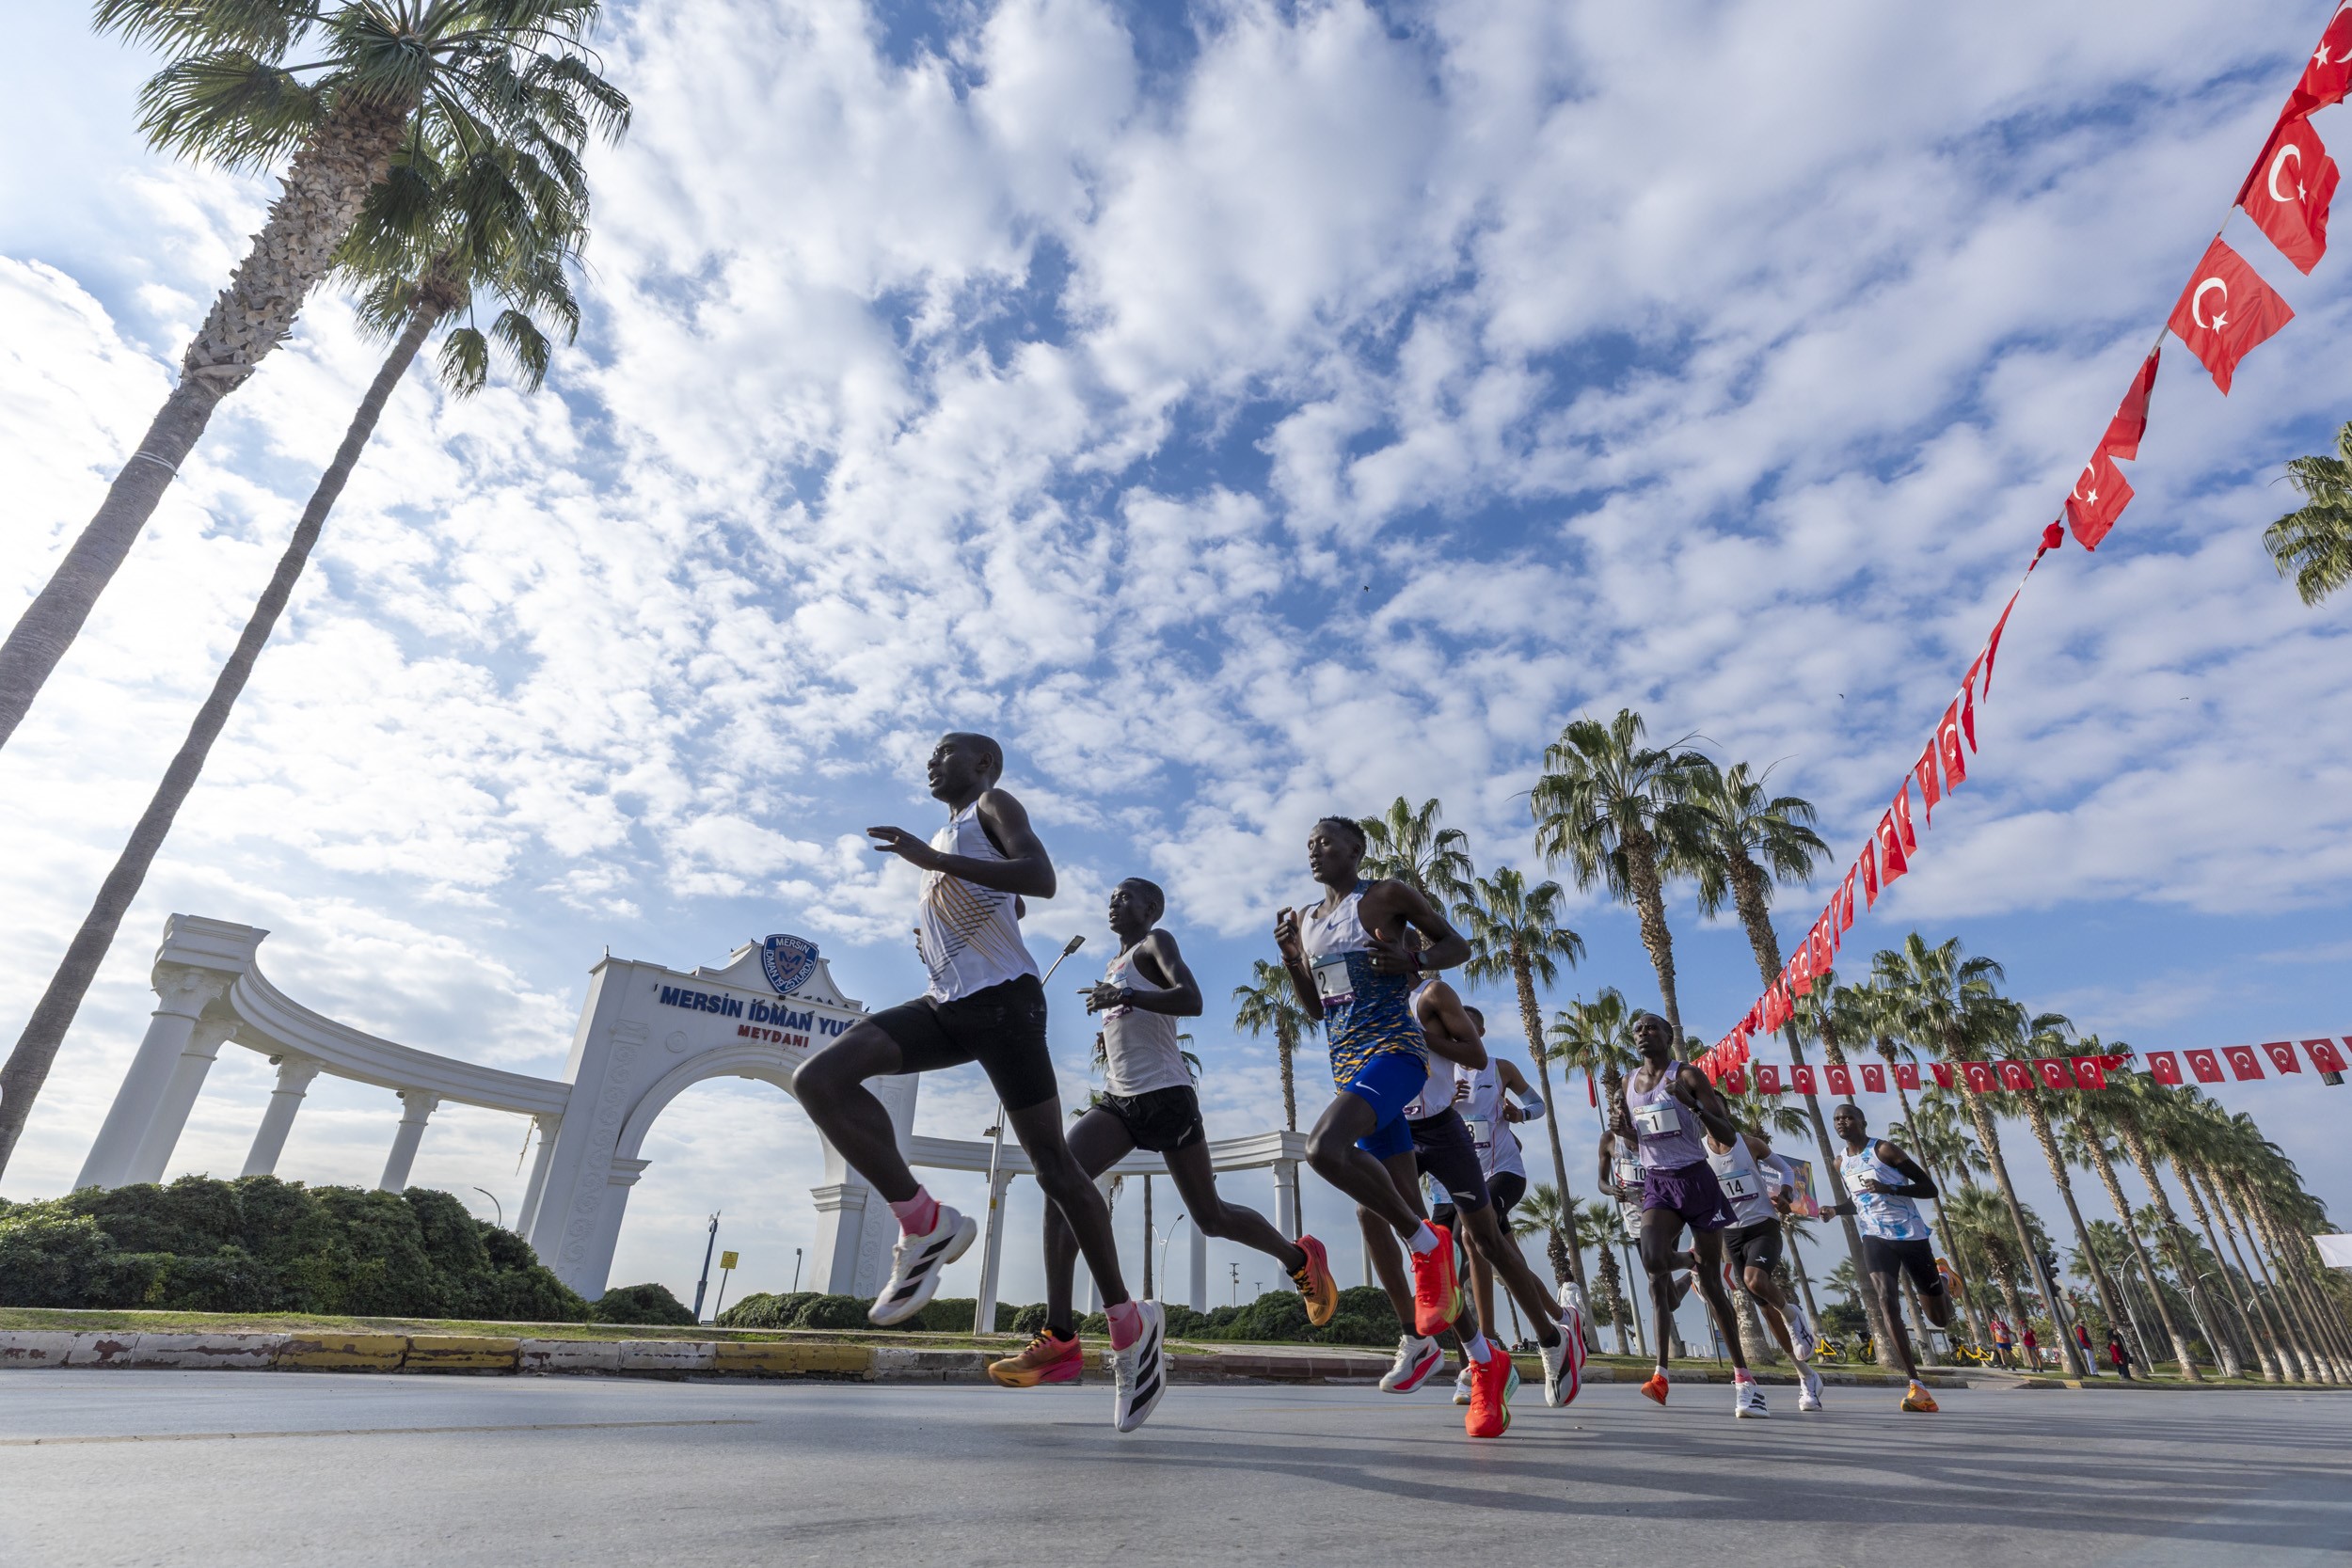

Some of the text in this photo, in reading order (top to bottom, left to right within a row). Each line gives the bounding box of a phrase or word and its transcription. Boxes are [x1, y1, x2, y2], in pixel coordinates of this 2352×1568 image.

[776, 938, 810, 954] MERSİN
[766, 949, 779, 978] İDMAN
[794, 958, 814, 984] YURDU
[774, 976, 796, 990] 1925
[1318, 971, 1329, 995] 2
[660, 986, 743, 1019] MERSİN
[748, 999, 814, 1032] İDMAN
[738, 1024, 810, 1048] MEYDANI
[1650, 1114, 1660, 1131] 1
[1633, 1167, 1646, 1180] 10
[1857, 1174, 1867, 1188] 5
[1725, 1180, 1744, 1196] 14
